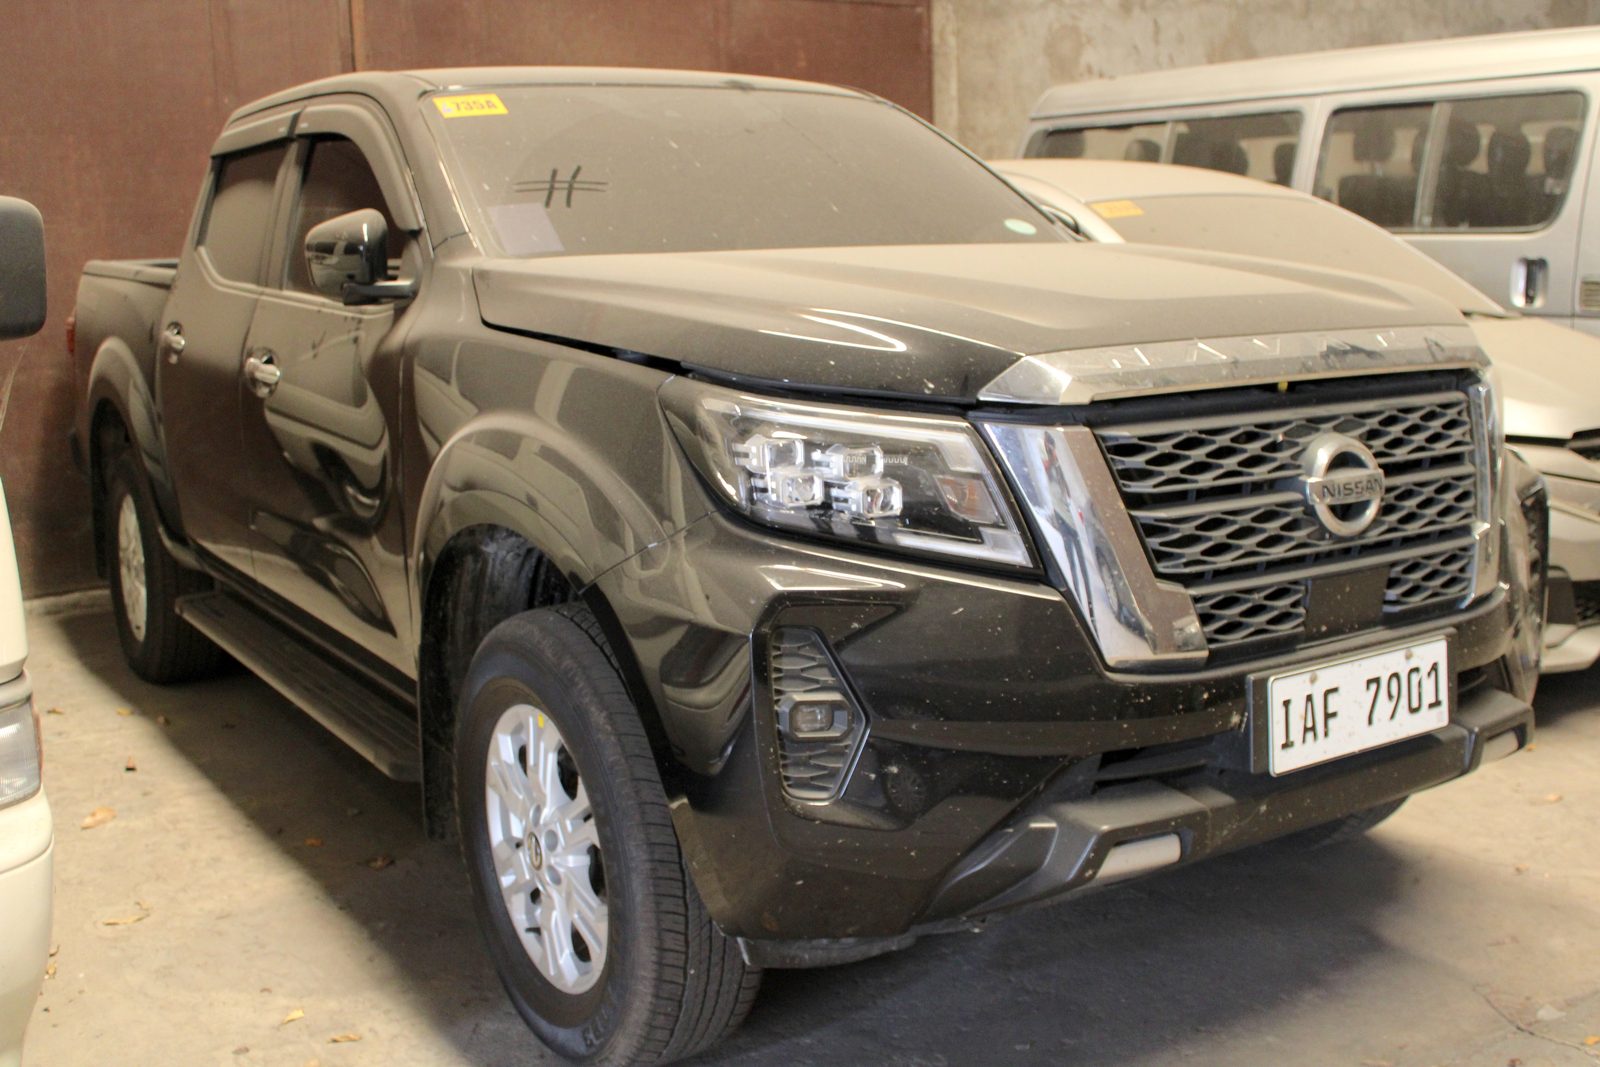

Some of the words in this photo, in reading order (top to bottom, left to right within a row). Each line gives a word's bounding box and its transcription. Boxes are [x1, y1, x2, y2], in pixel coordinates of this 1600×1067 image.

[1321, 478, 1383, 498] NISSAN
[1281, 686, 1340, 750] IAF
[1365, 661, 1442, 727] 7901
